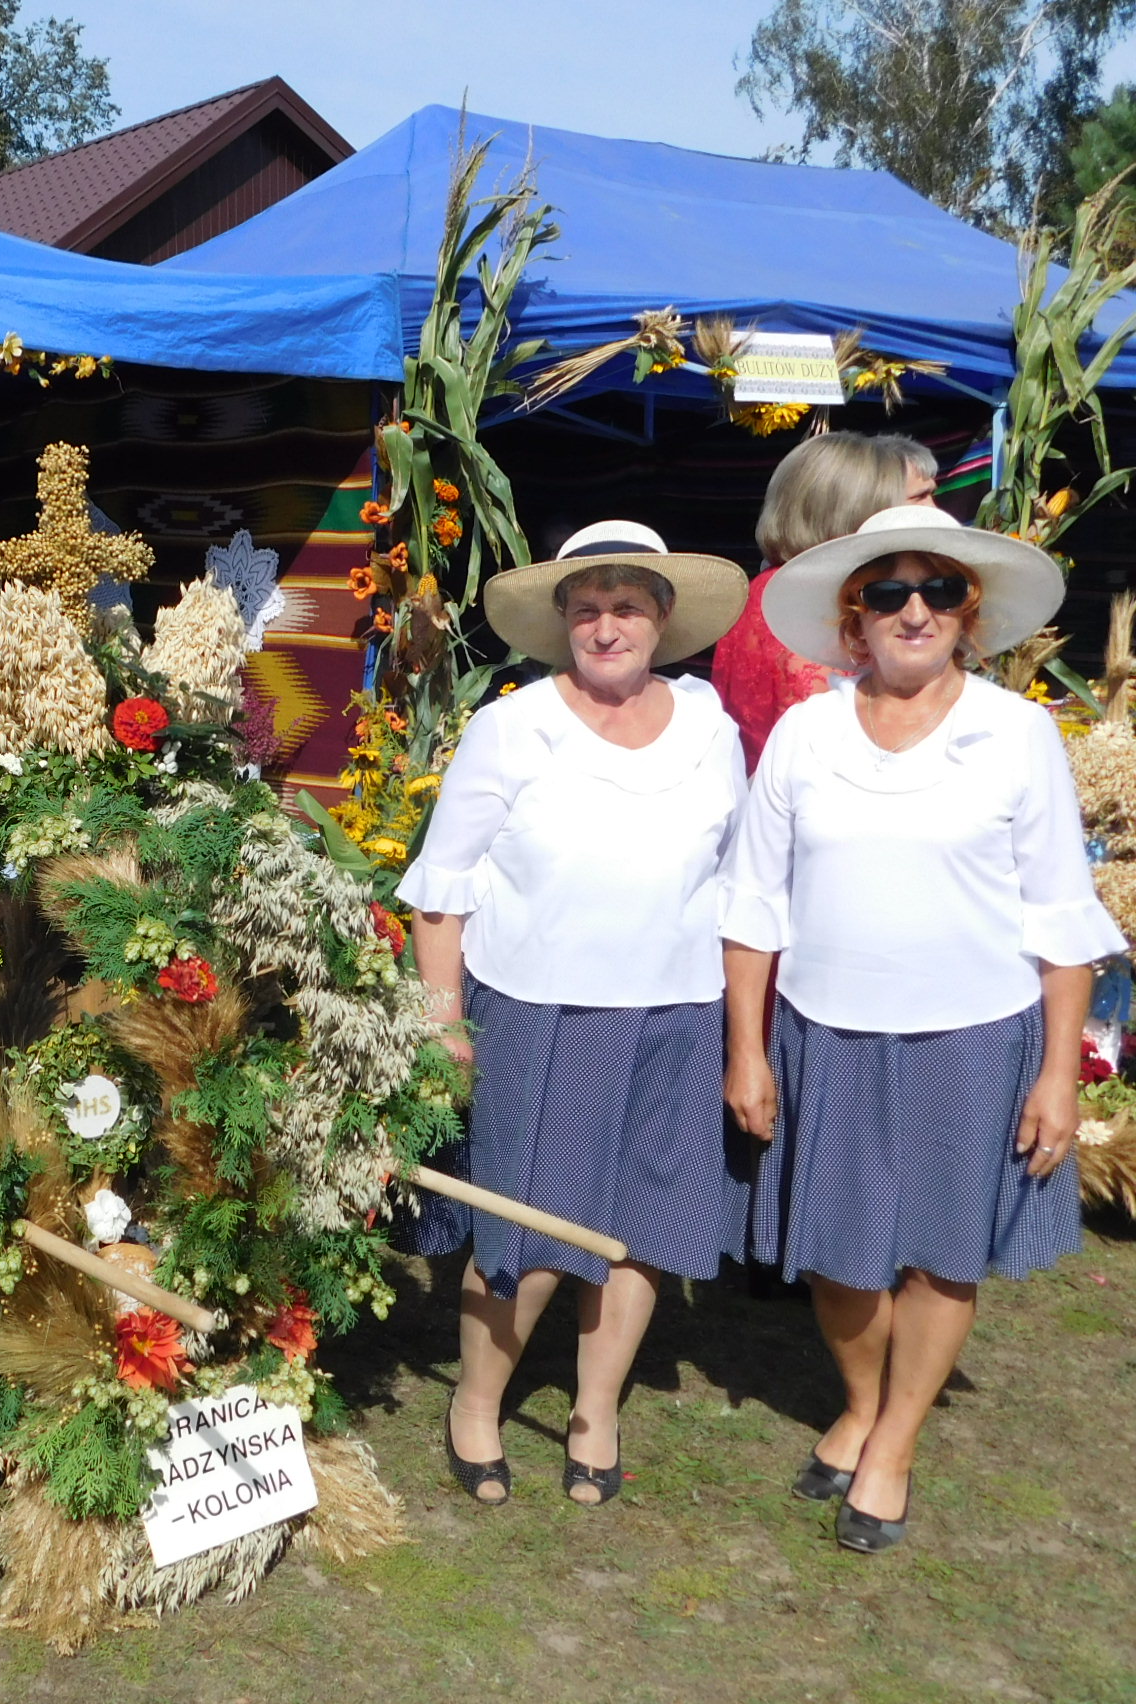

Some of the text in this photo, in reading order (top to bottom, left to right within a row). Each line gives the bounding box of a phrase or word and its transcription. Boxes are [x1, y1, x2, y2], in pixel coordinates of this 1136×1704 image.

[737, 358, 834, 378] BULITÓW DUŻY
[75, 1095, 112, 1118] IHS
